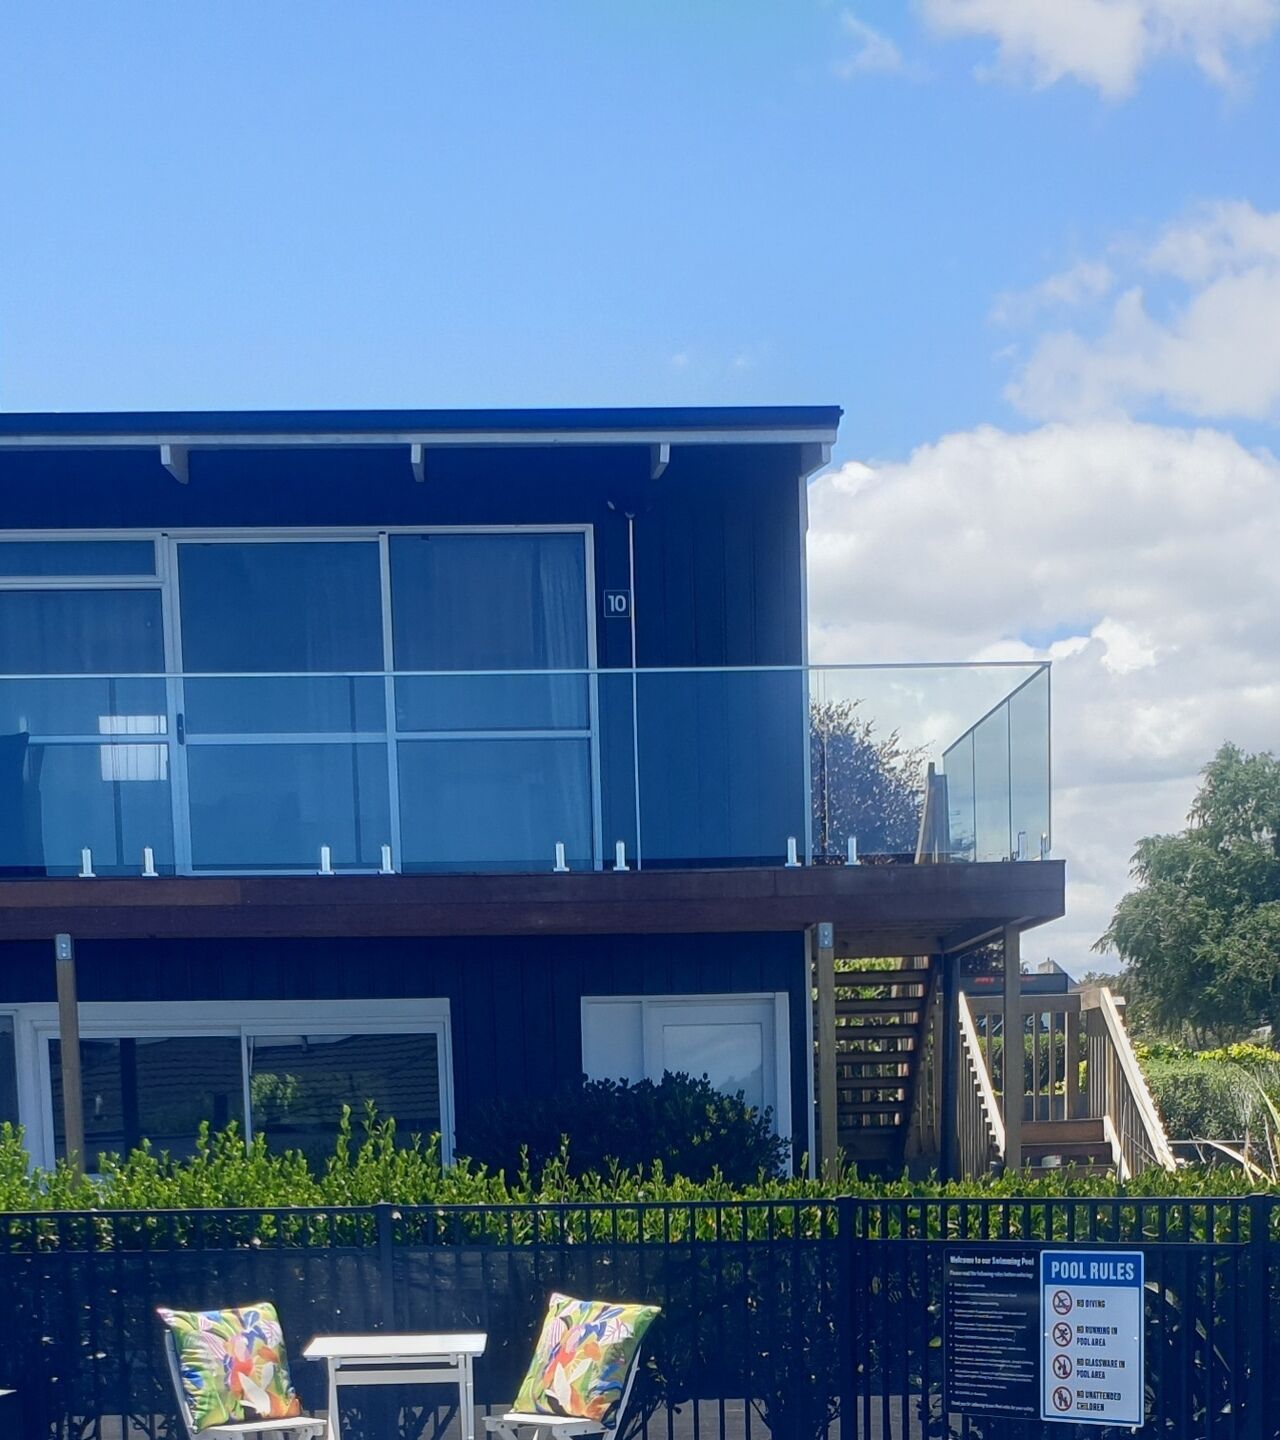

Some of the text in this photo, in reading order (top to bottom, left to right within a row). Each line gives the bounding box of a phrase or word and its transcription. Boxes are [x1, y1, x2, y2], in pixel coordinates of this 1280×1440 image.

[607, 595, 627, 612] 10
[949, 1255, 974, 1264] Welcome
[992, 1256, 1021, 1267] Swimming
[1022, 1257, 1034, 1266] Pool
[1051, 1261, 1134, 1280] POOL RULES
[1085, 1300, 1105, 1308] DIVING
[1085, 1326, 1110, 1334] RUNNING
[1111, 1327, 1117, 1335] IN
[1077, 1338, 1106, 1346] POOL AREA
[1077, 1358, 1125, 1368] NO GLASSWARE IN
[1077, 1370, 1106, 1379] POOL AREA
[1085, 1391, 1122, 1400] UNATTENDED
[1077, 1402, 1105, 1411] CHILDREN
